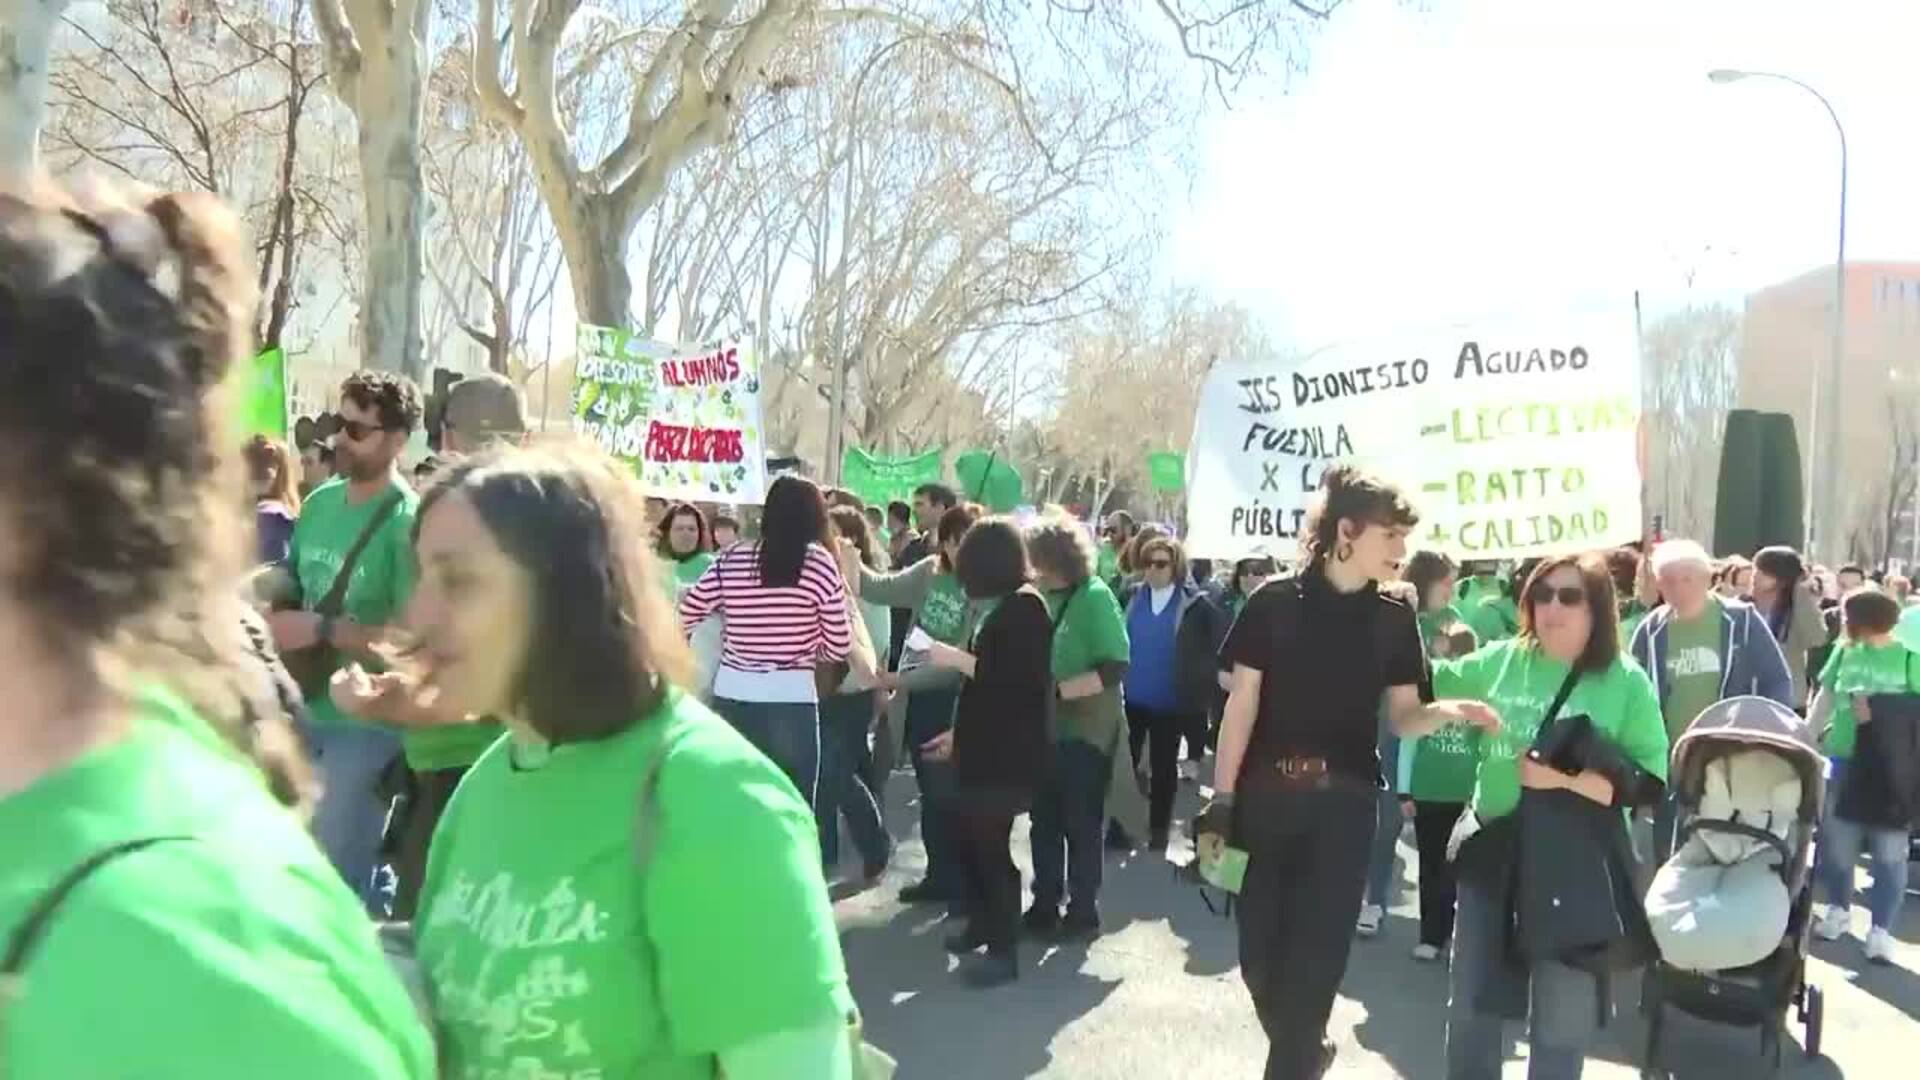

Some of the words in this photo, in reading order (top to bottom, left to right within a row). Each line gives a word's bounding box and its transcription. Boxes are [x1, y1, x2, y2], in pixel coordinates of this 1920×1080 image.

[660, 347, 741, 387] ALUMNOS
[1292, 358, 1429, 407] DIONISIO
[1243, 422, 1354, 459] FUENLA
[1259, 462, 1279, 492] X
